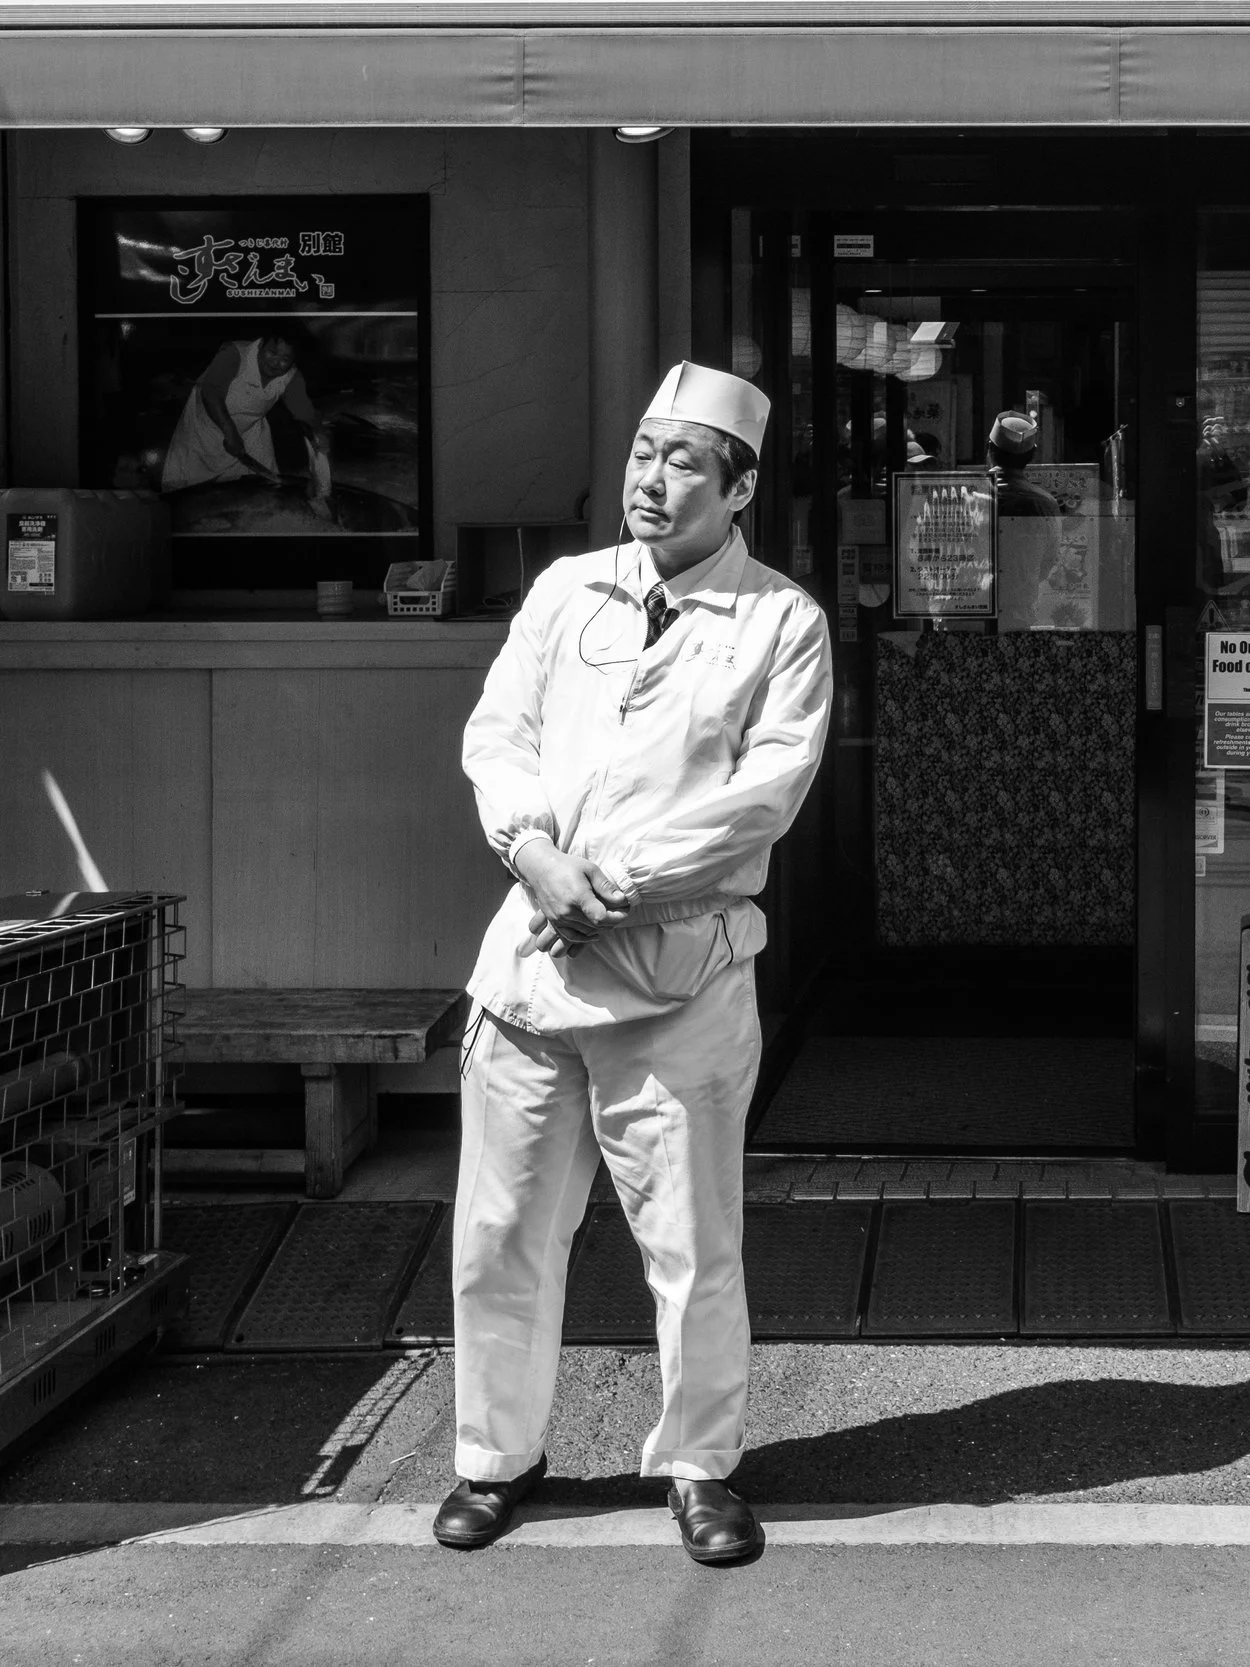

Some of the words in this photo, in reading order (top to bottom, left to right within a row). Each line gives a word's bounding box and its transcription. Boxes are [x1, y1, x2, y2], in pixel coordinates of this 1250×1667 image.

[299, 231, 345, 256] 別館
[226, 288, 297, 298] SUSHIZANMAI
[1220, 640, 1236, 655] No
[1212, 659, 1243, 673] Food
